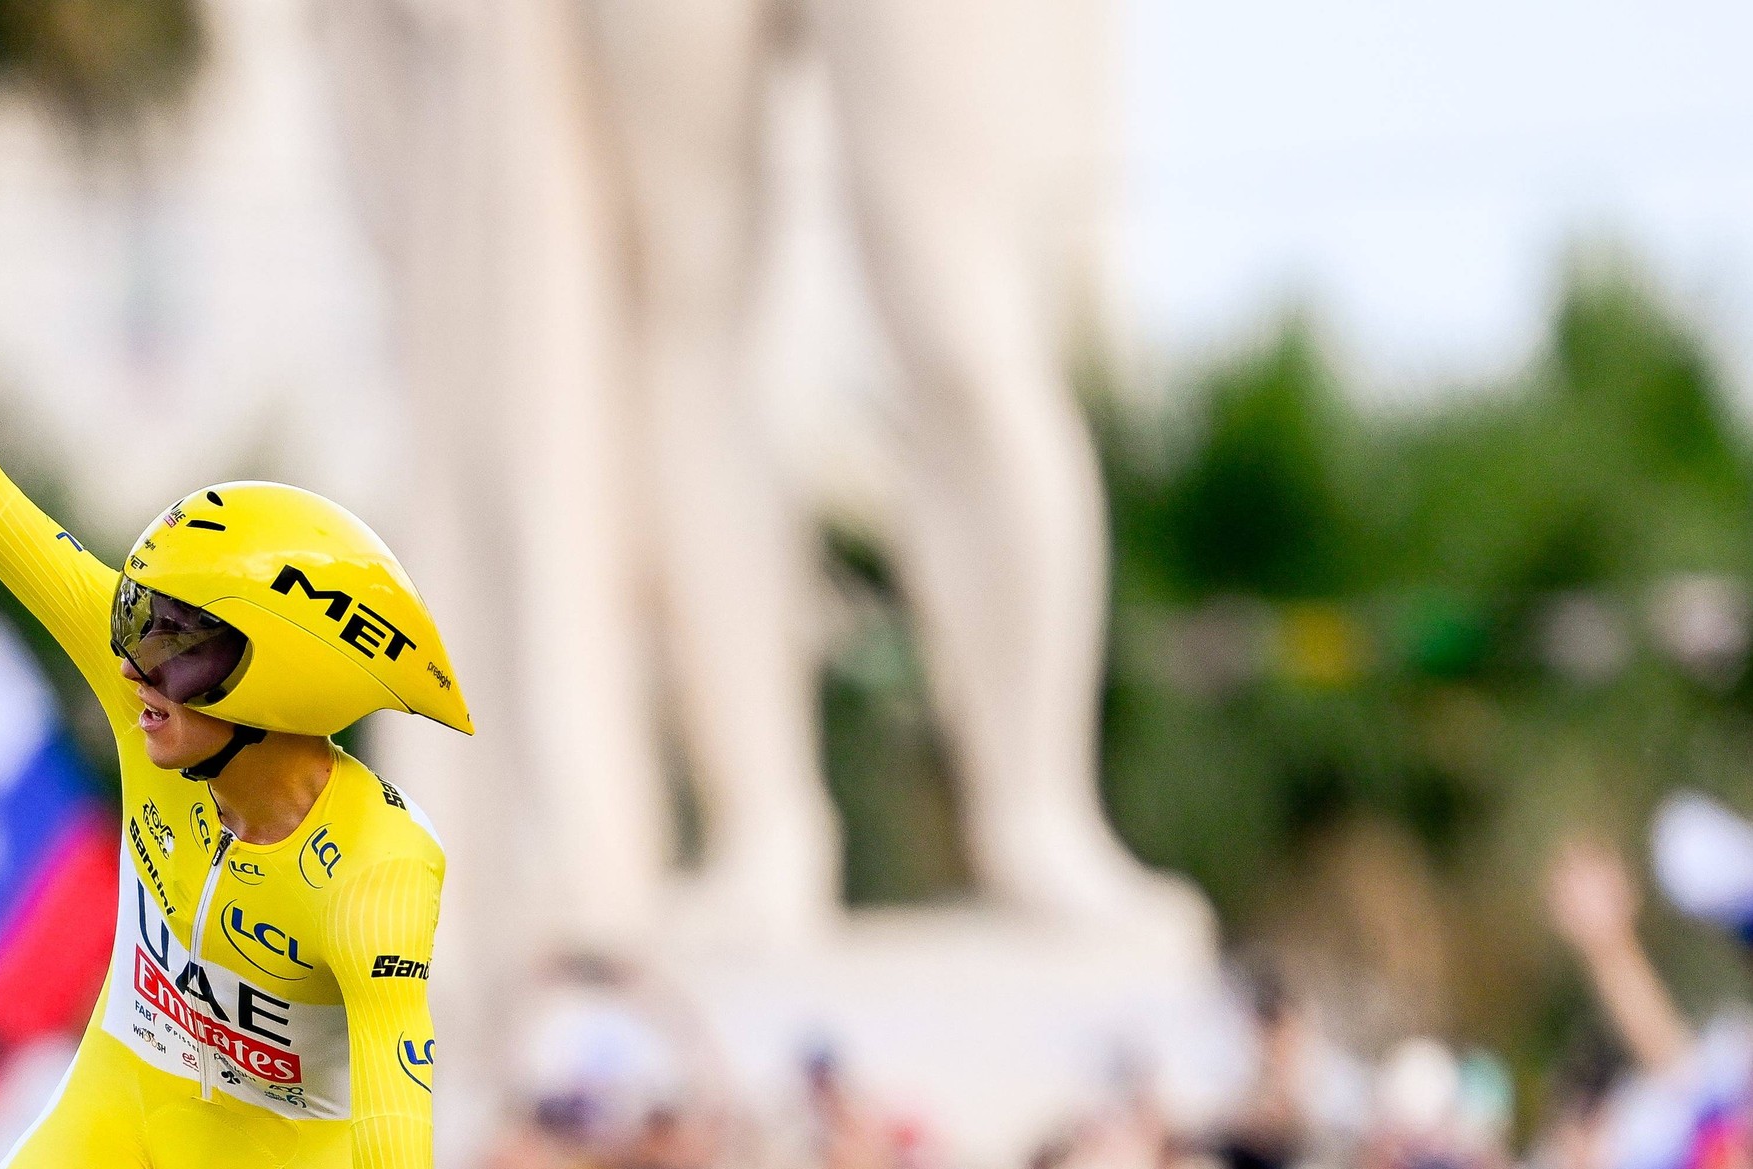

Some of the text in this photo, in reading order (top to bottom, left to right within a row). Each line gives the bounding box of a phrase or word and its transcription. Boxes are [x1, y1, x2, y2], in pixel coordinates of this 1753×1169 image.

[269, 564, 418, 663] MET
[427, 661, 452, 691] presight
[195, 805, 212, 855] LCL
[311, 827, 342, 879] LCL
[129, 816, 177, 916] Santini
[230, 860, 266, 877] LCL
[137, 876, 292, 1047] UAE
[231, 906, 314, 970] LCL
[138, 962, 296, 1080] Emirates
